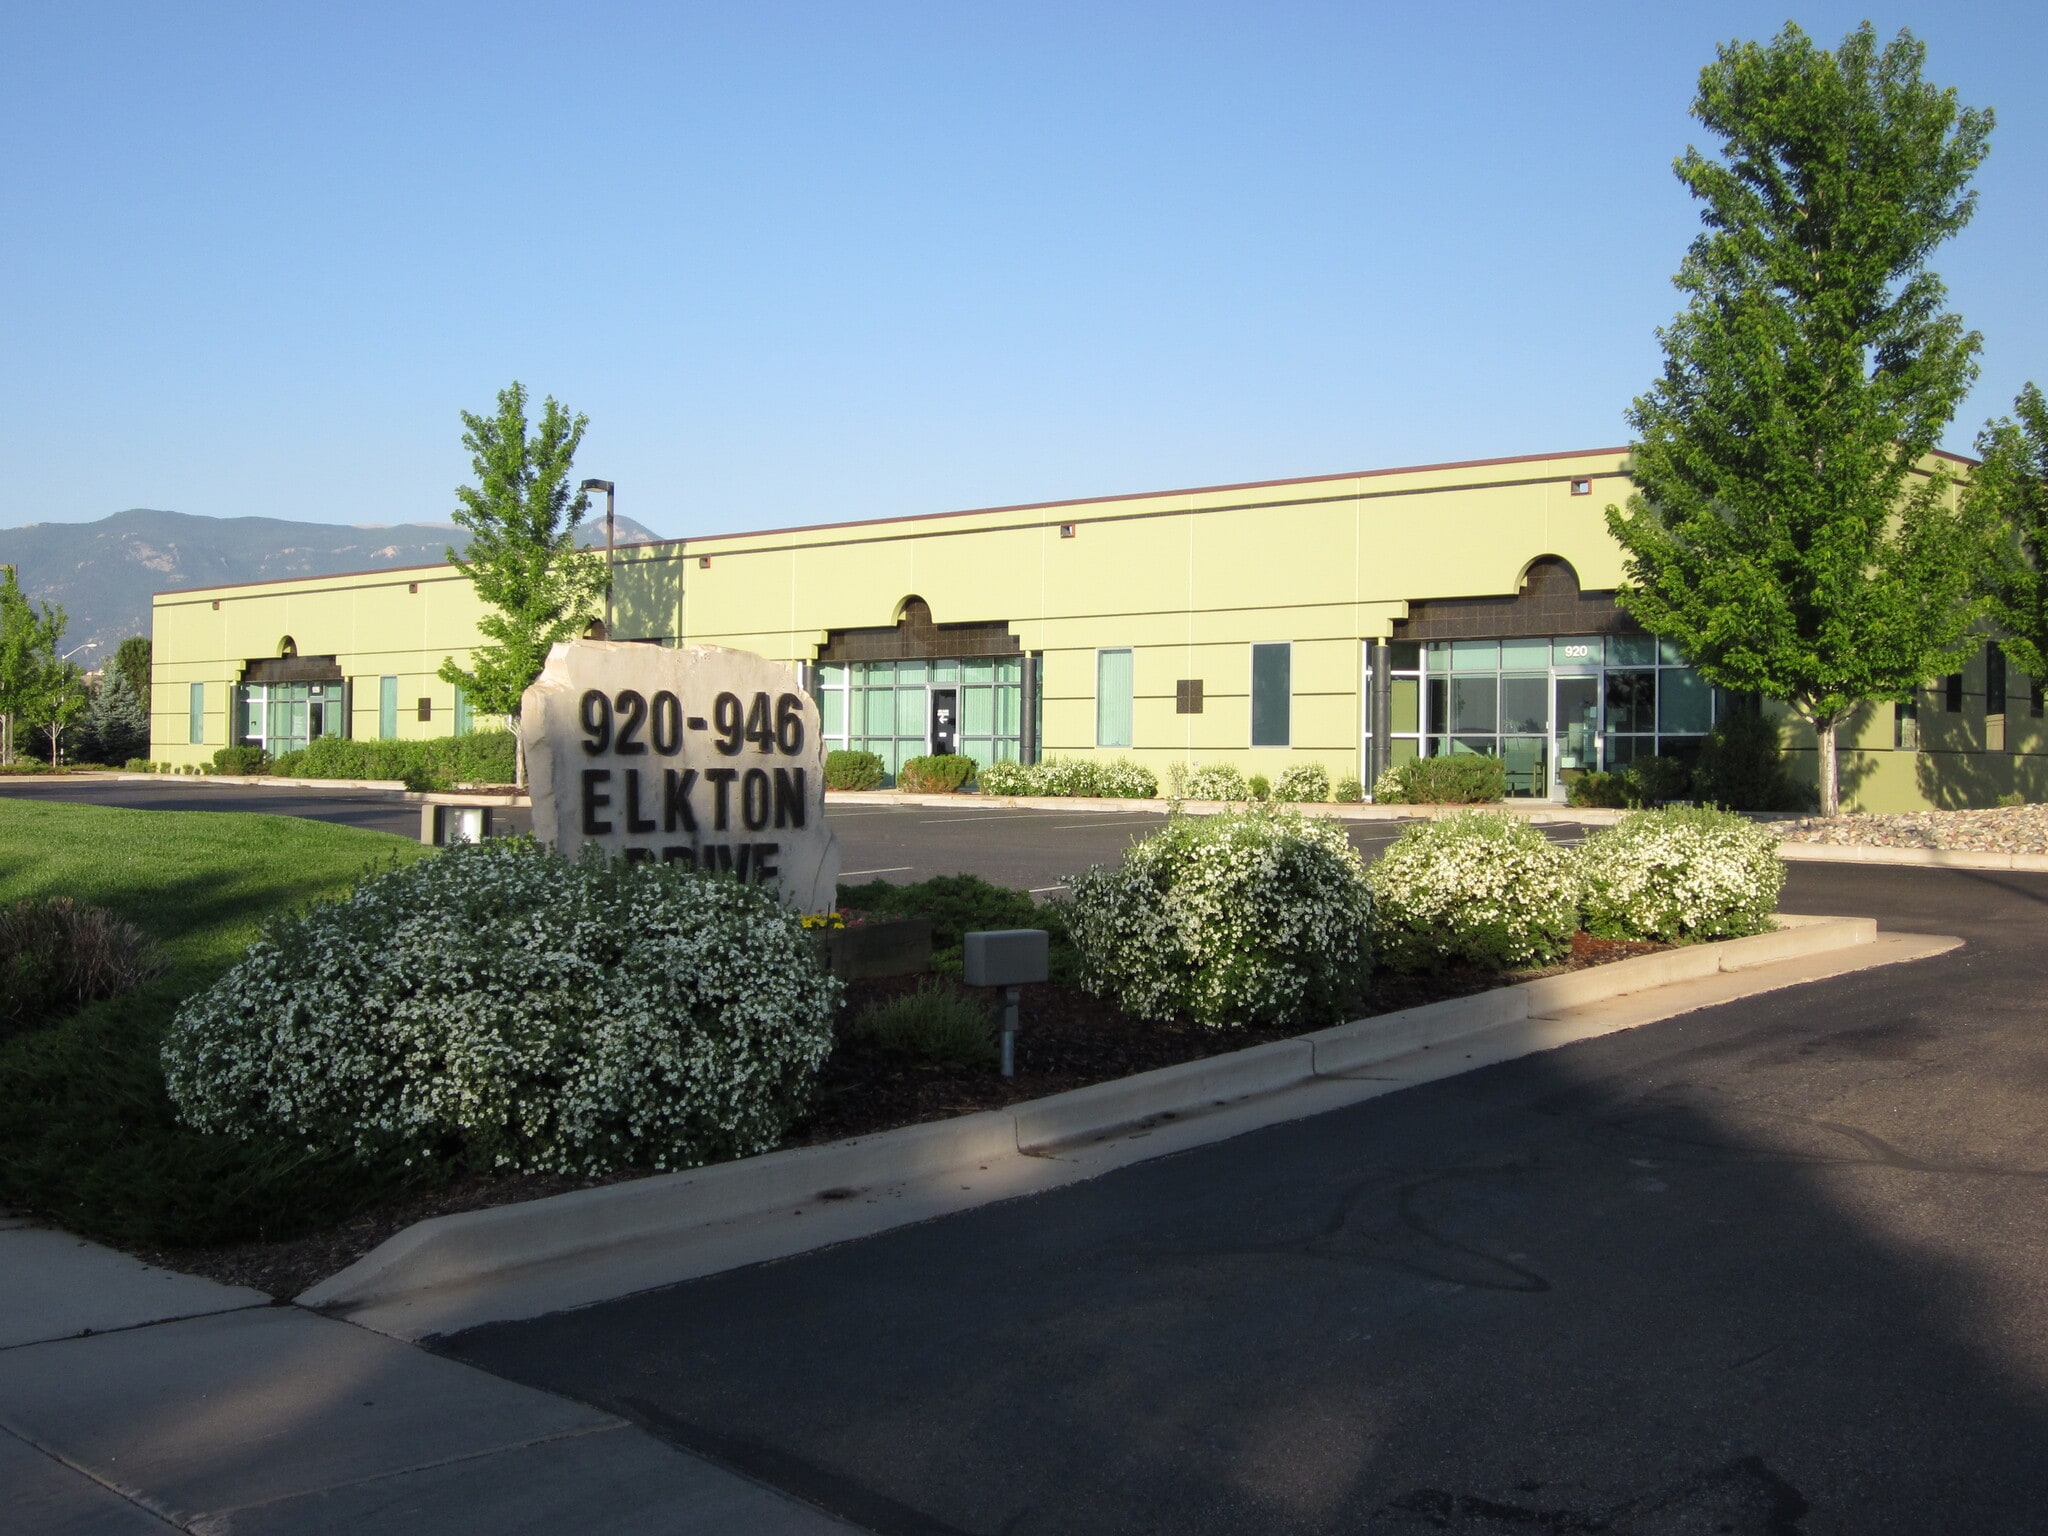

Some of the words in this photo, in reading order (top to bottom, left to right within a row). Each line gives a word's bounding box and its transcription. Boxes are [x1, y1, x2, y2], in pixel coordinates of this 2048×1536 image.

[1564, 645, 1588, 657] 920
[579, 689, 805, 756] 920-946
[581, 767, 806, 835] ELKTON
[625, 843, 779, 890] IVE
